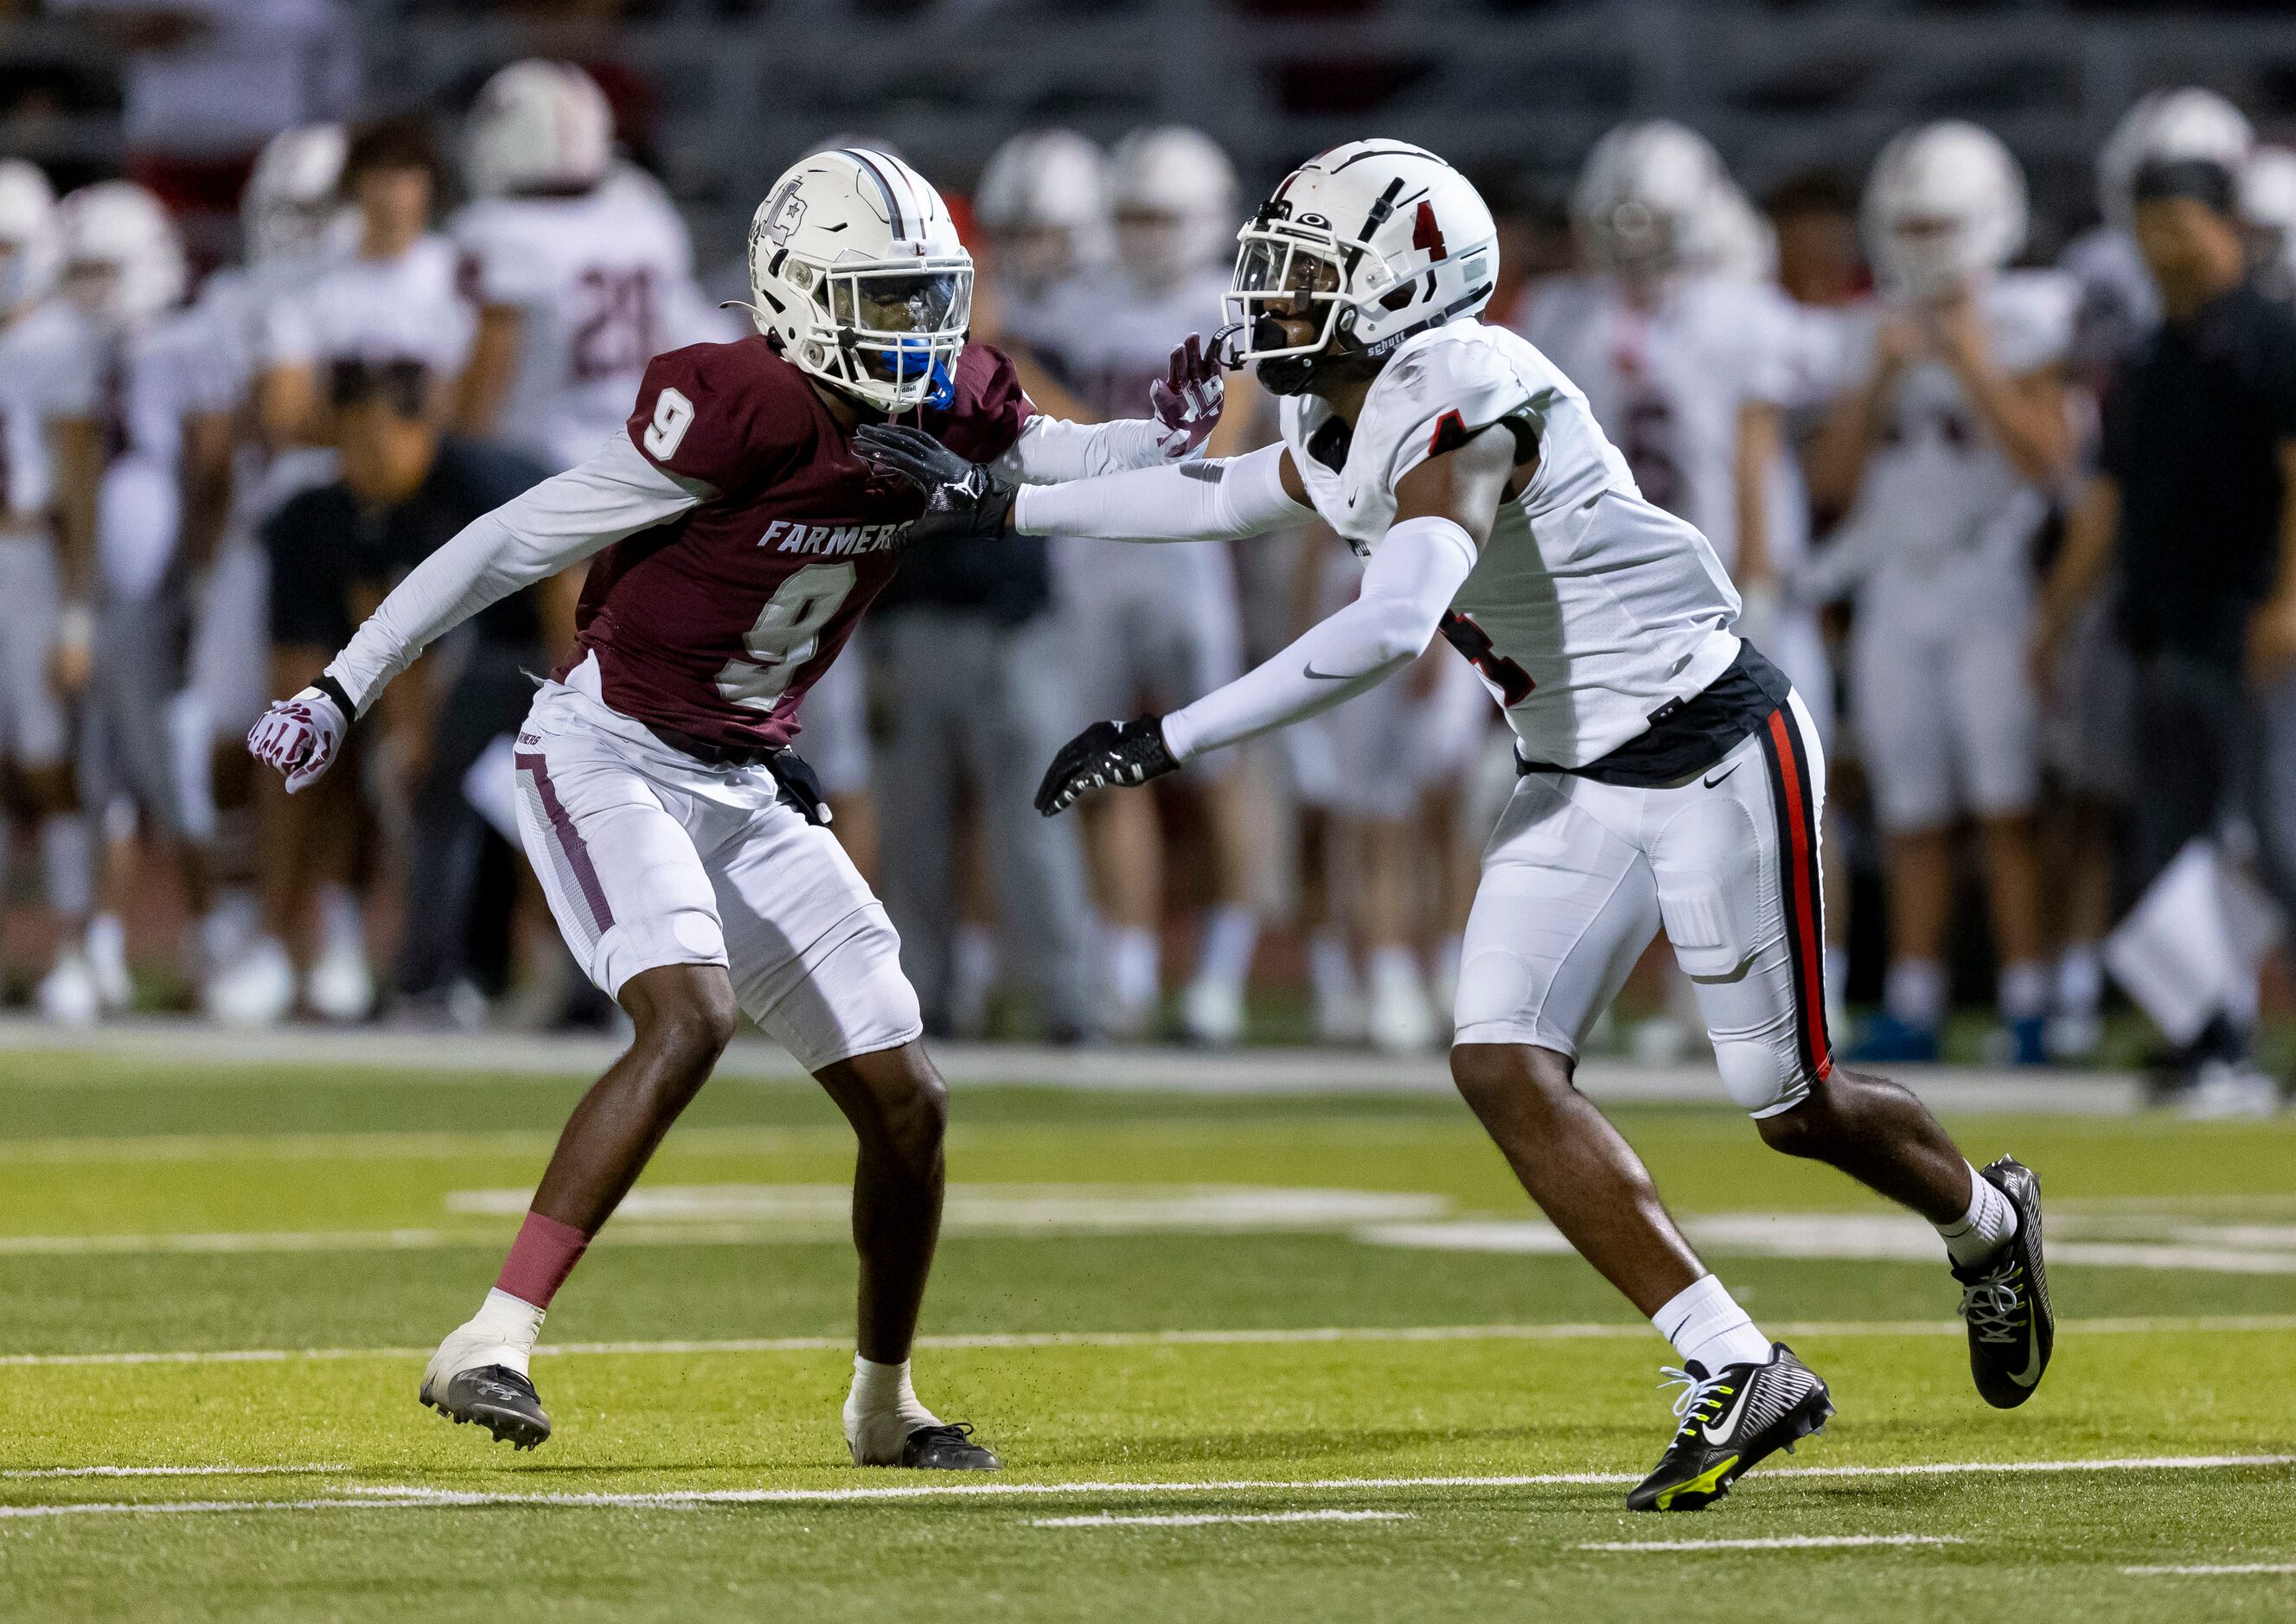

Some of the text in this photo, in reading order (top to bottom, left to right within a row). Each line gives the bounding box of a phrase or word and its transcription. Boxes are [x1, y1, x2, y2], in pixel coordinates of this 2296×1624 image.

[1412, 199, 1449, 263] 4
[1367, 330, 1406, 356] schutt
[644, 387, 694, 461] 9
[713, 561, 857, 713] 9
